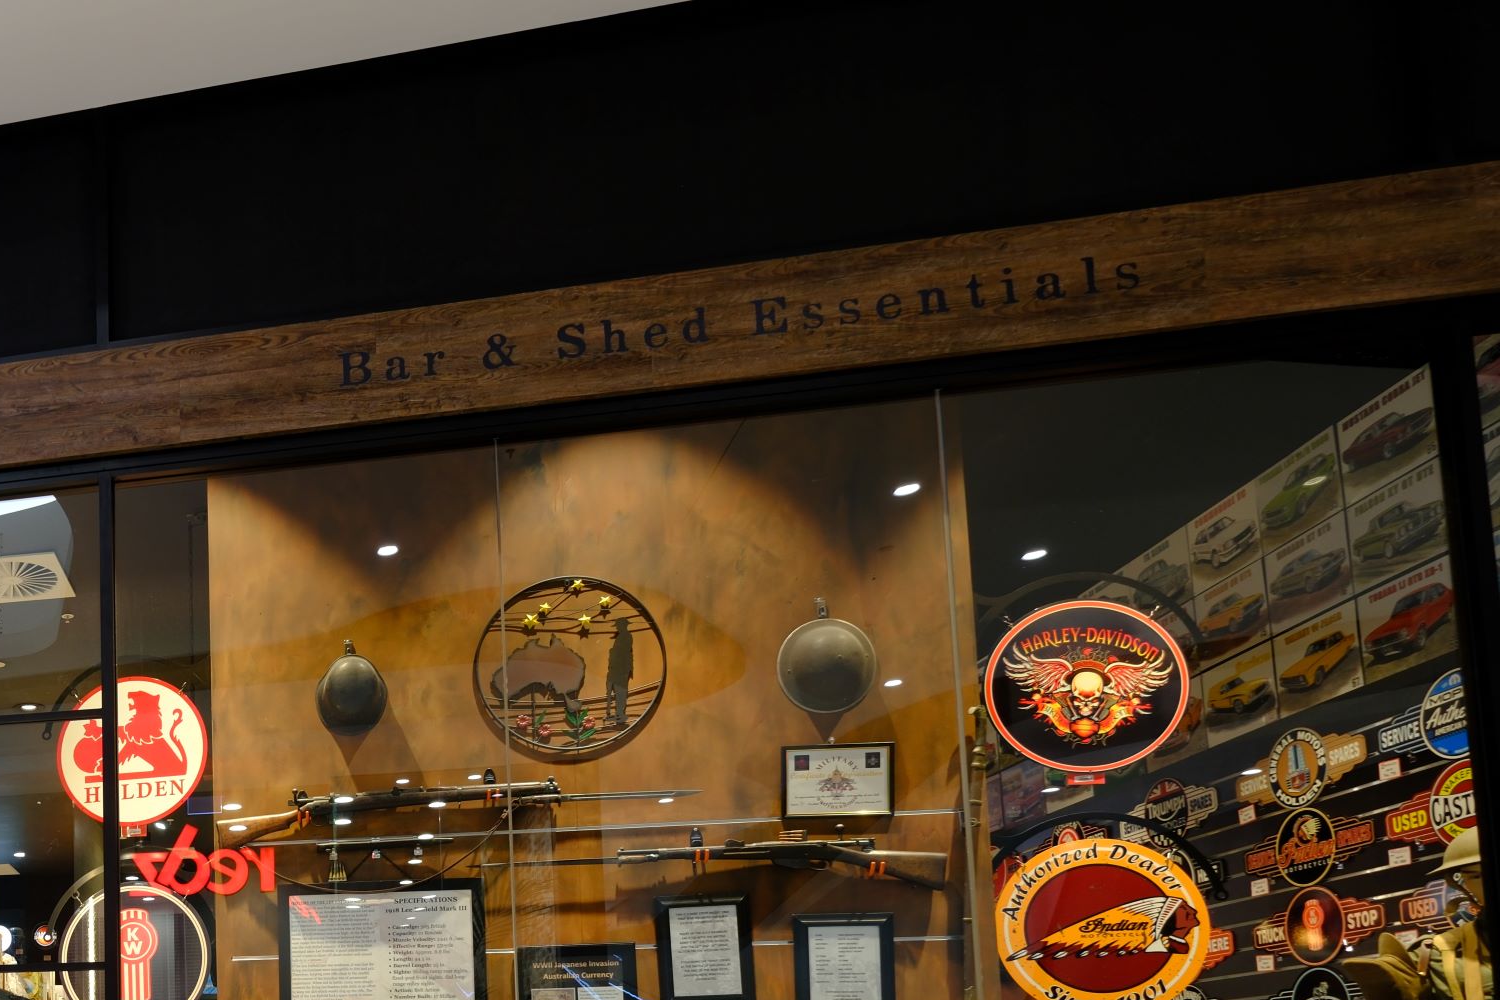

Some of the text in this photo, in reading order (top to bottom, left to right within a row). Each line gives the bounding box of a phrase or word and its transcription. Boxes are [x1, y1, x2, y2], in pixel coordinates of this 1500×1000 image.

[338, 255, 1142, 388] Bar & Shed Essentials
[1380, 720, 1421, 749] SERVICE
[1269, 730, 1327, 783] GENERAL MOTORS
[1328, 741, 1361, 766] SPARES
[84, 778, 186, 804] HLDEN
[1239, 773, 1269, 797] SERVICE
[1275, 779, 1323, 806] HOLDEN
[1146, 794, 1186, 820] TRIUMPH
[1391, 808, 1428, 833] USED
[1001, 842, 1183, 921] Authorized Dealer
[394, 896, 459, 904] SPECIFICATIONS
[1407, 897, 1438, 920] USED
[1078, 917, 1149, 935] Indian
[1346, 909, 1379, 930] STOP
[127, 927, 138, 941] K
[1256, 928, 1286, 945] TRUCK
[122, 941, 143, 956] W
[588, 959, 620, 968] Invasion
[581, 971, 614, 981] Currency
